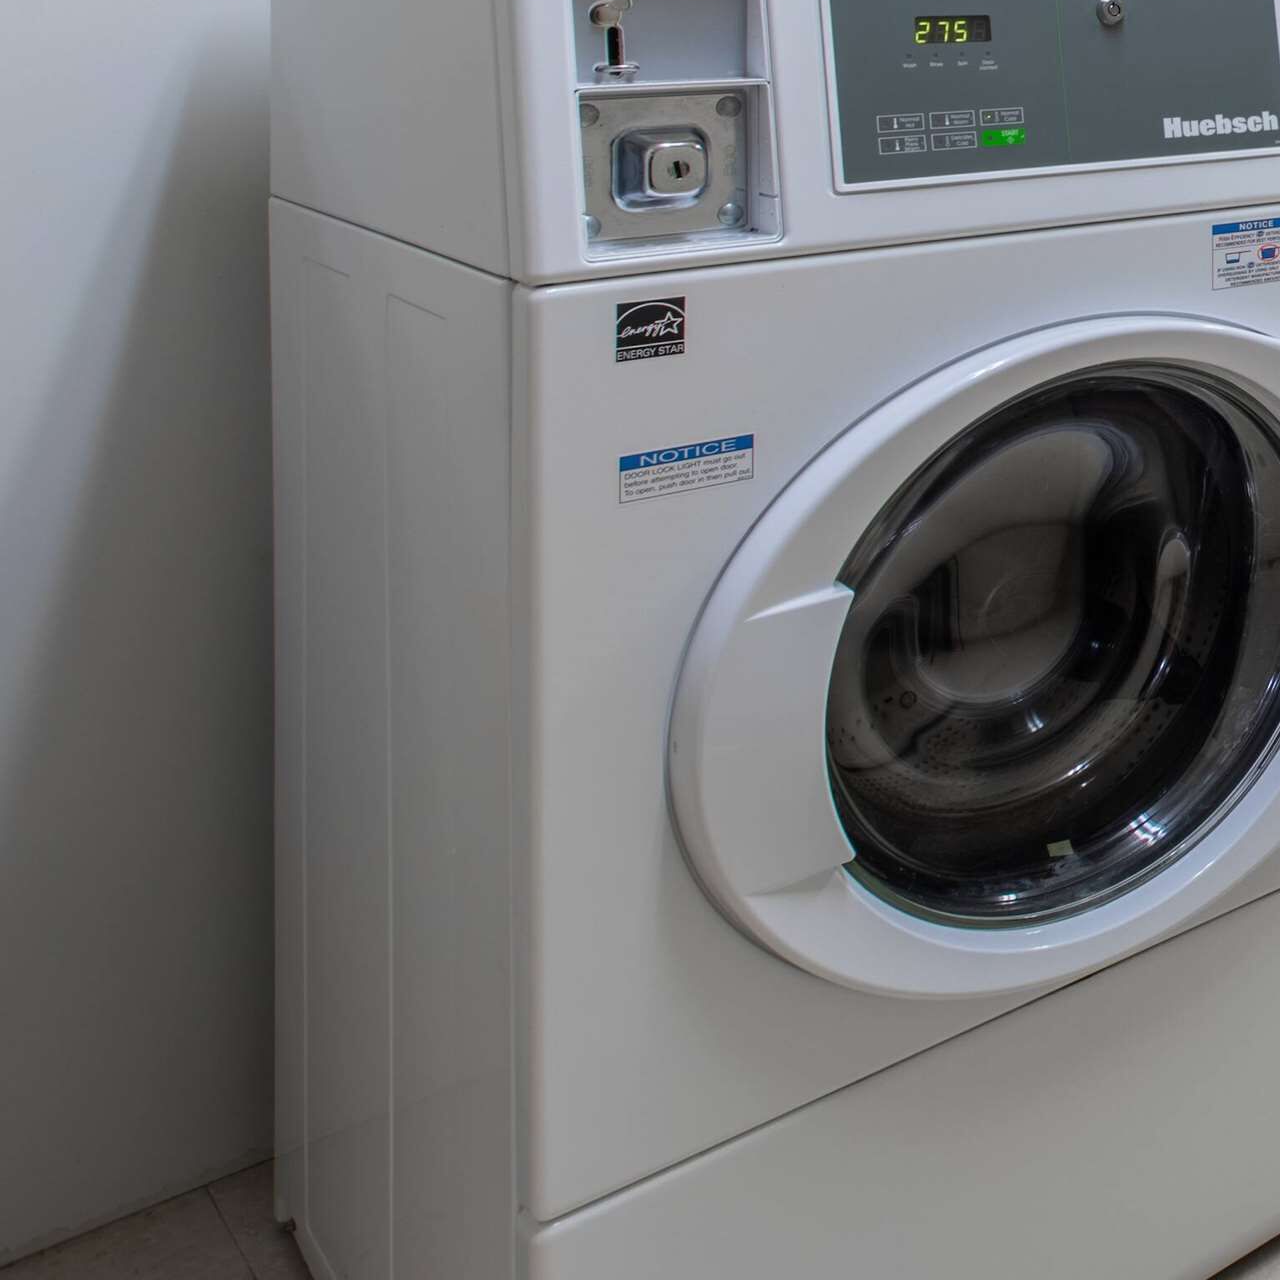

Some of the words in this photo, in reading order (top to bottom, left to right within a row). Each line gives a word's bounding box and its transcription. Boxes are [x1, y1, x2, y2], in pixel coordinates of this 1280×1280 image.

[1162, 111, 1280, 138] Huebsch
[1239, 220, 1275, 231] NOTICE
[617, 346, 657, 361] ENERGY
[658, 343, 684, 355] STAR
[640, 439, 737, 466] NOTICE
